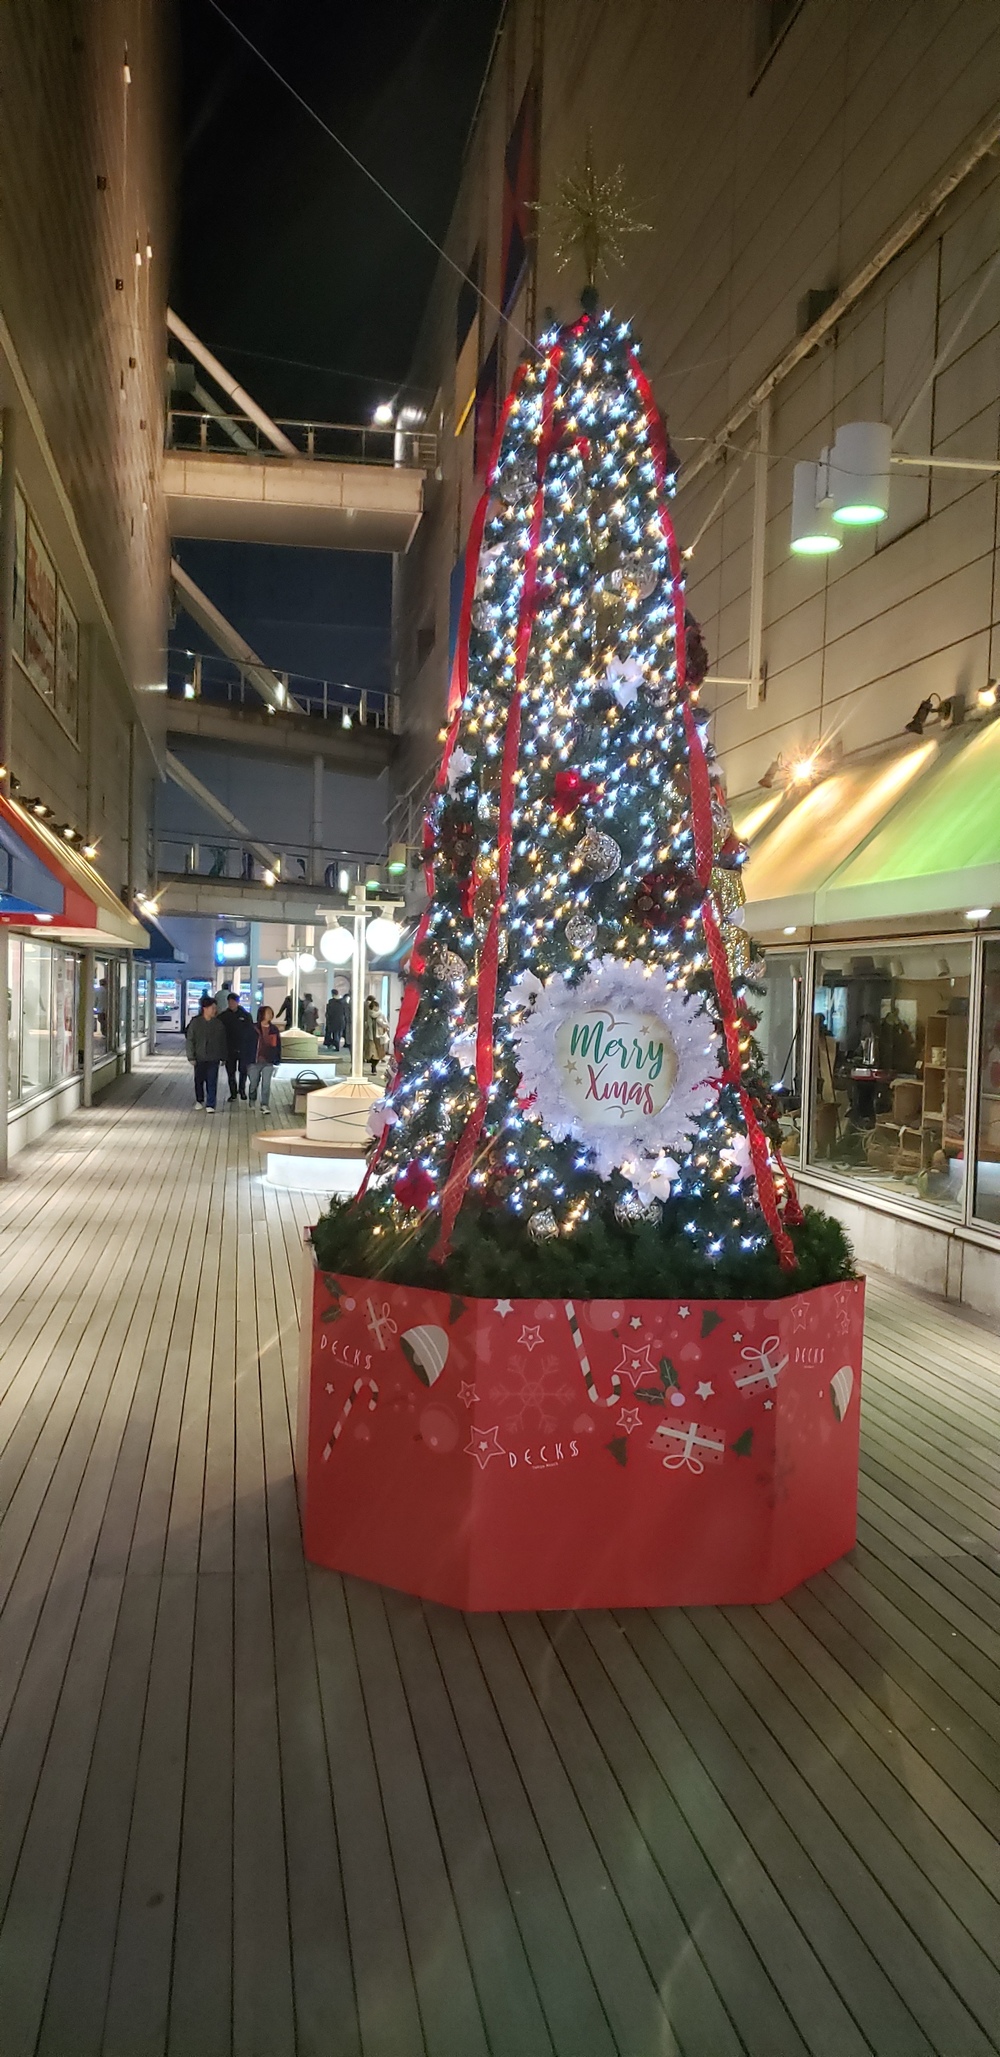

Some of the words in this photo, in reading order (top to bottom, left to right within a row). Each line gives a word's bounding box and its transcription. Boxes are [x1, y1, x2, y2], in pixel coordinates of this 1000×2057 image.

[570, 1020, 664, 1080] Merry
[584, 1063, 654, 1115] Xmas
[320, 1334, 373, 1370] DECKS
[794, 1346, 825, 1364] DECKS
[509, 1440, 579, 1468] DECKS
